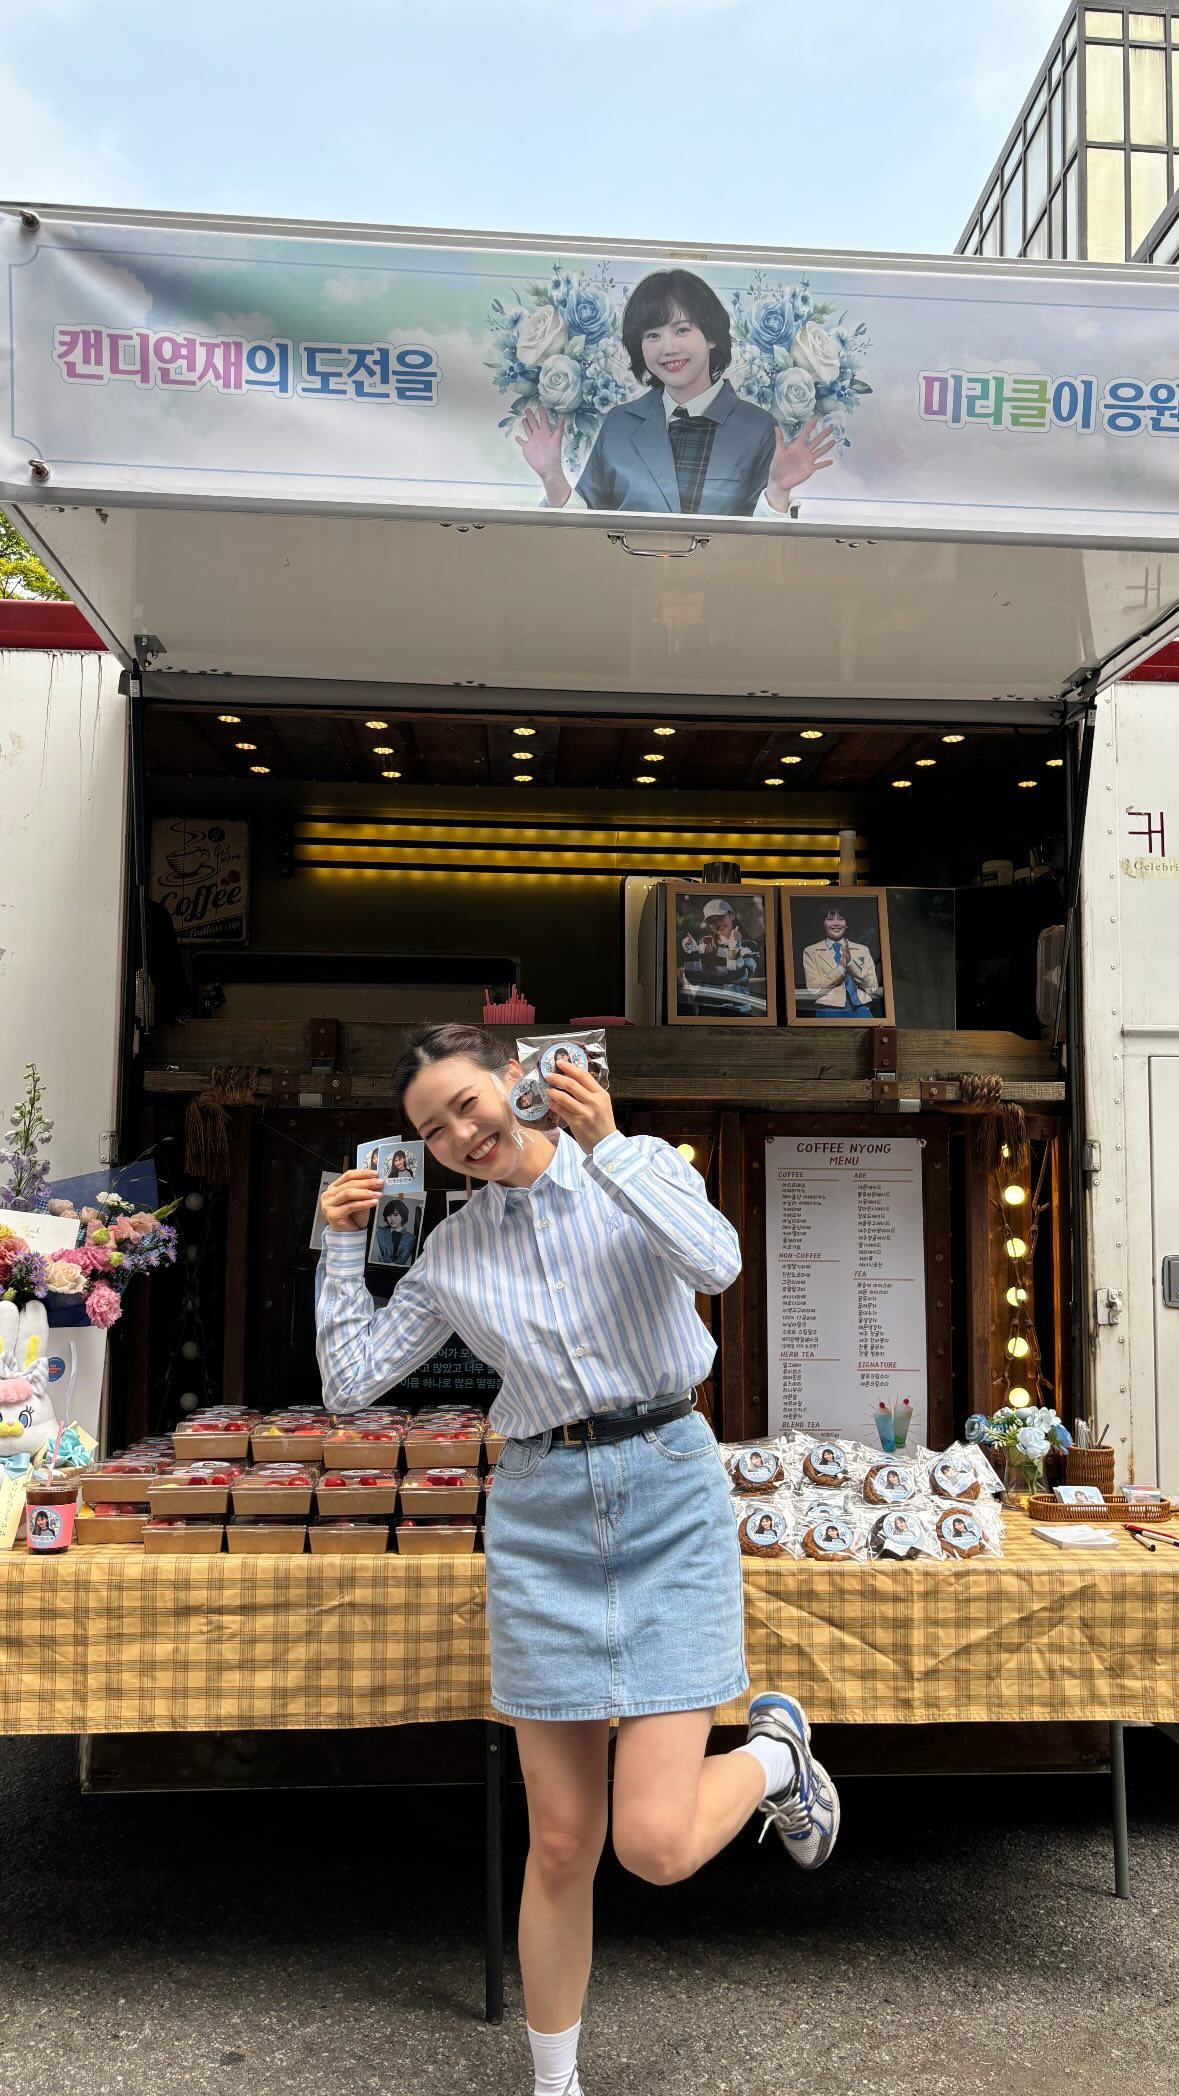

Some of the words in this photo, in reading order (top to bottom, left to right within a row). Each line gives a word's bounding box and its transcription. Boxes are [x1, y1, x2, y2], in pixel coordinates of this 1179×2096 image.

[55, 328, 290, 395] 캔디연재의
[301, 342, 437, 402] 도전을
[922, 373, 1094, 430] 미라클이
[160, 883, 242, 922] Coffee
[797, 1143, 844, 1153] COFFEE
[849, 1143, 891, 1153] NYONG
[829, 1156, 859, 1165] MENU
[432, 1348, 458, 1359] 어가
[432, 1363, 463, 1374] 많았고
[464, 1363, 484, 1374] 너무
[400, 1378, 420, 1389] 이름
[422, 1378, 453, 1389] 하나로
[454, 1378, 474, 1389] 많은
